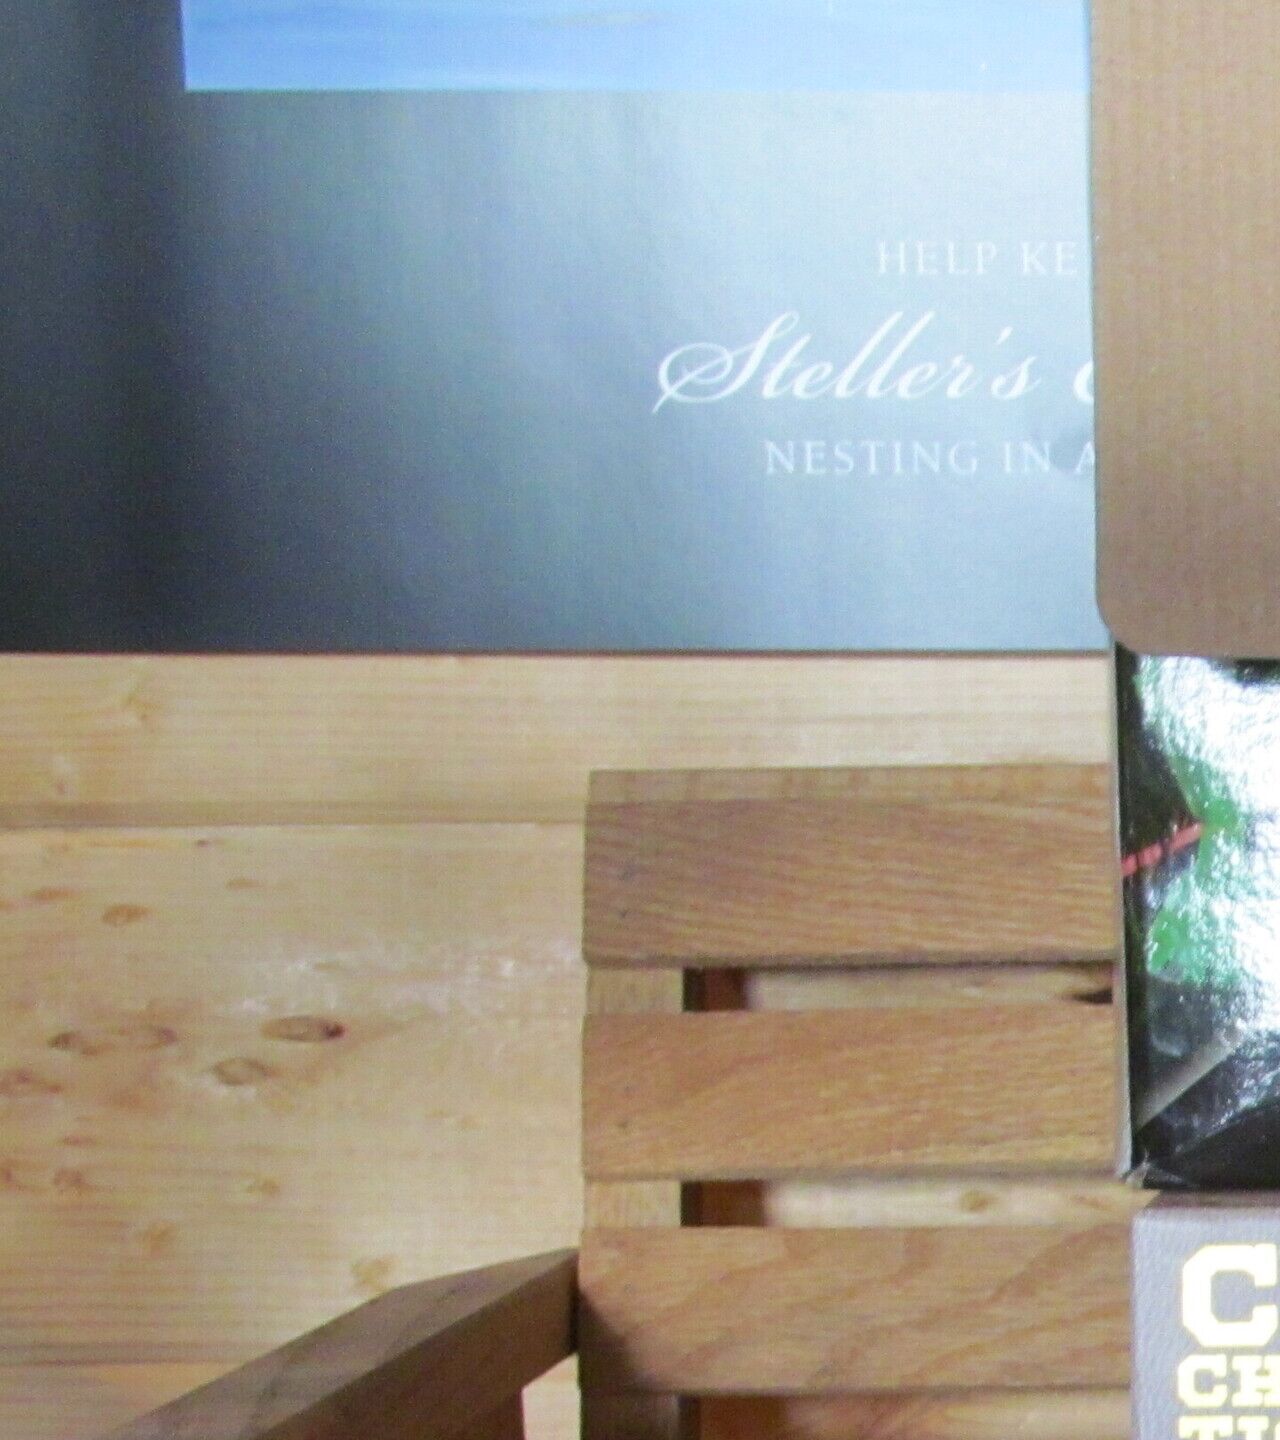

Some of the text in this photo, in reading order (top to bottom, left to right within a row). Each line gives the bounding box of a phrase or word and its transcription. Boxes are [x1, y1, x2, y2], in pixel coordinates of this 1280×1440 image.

[877, 240, 997, 276] HELP
[651, 310, 1041, 415] Steller's
[765, 440, 979, 476] NESTING
[1002, 441, 1051, 474] IN
